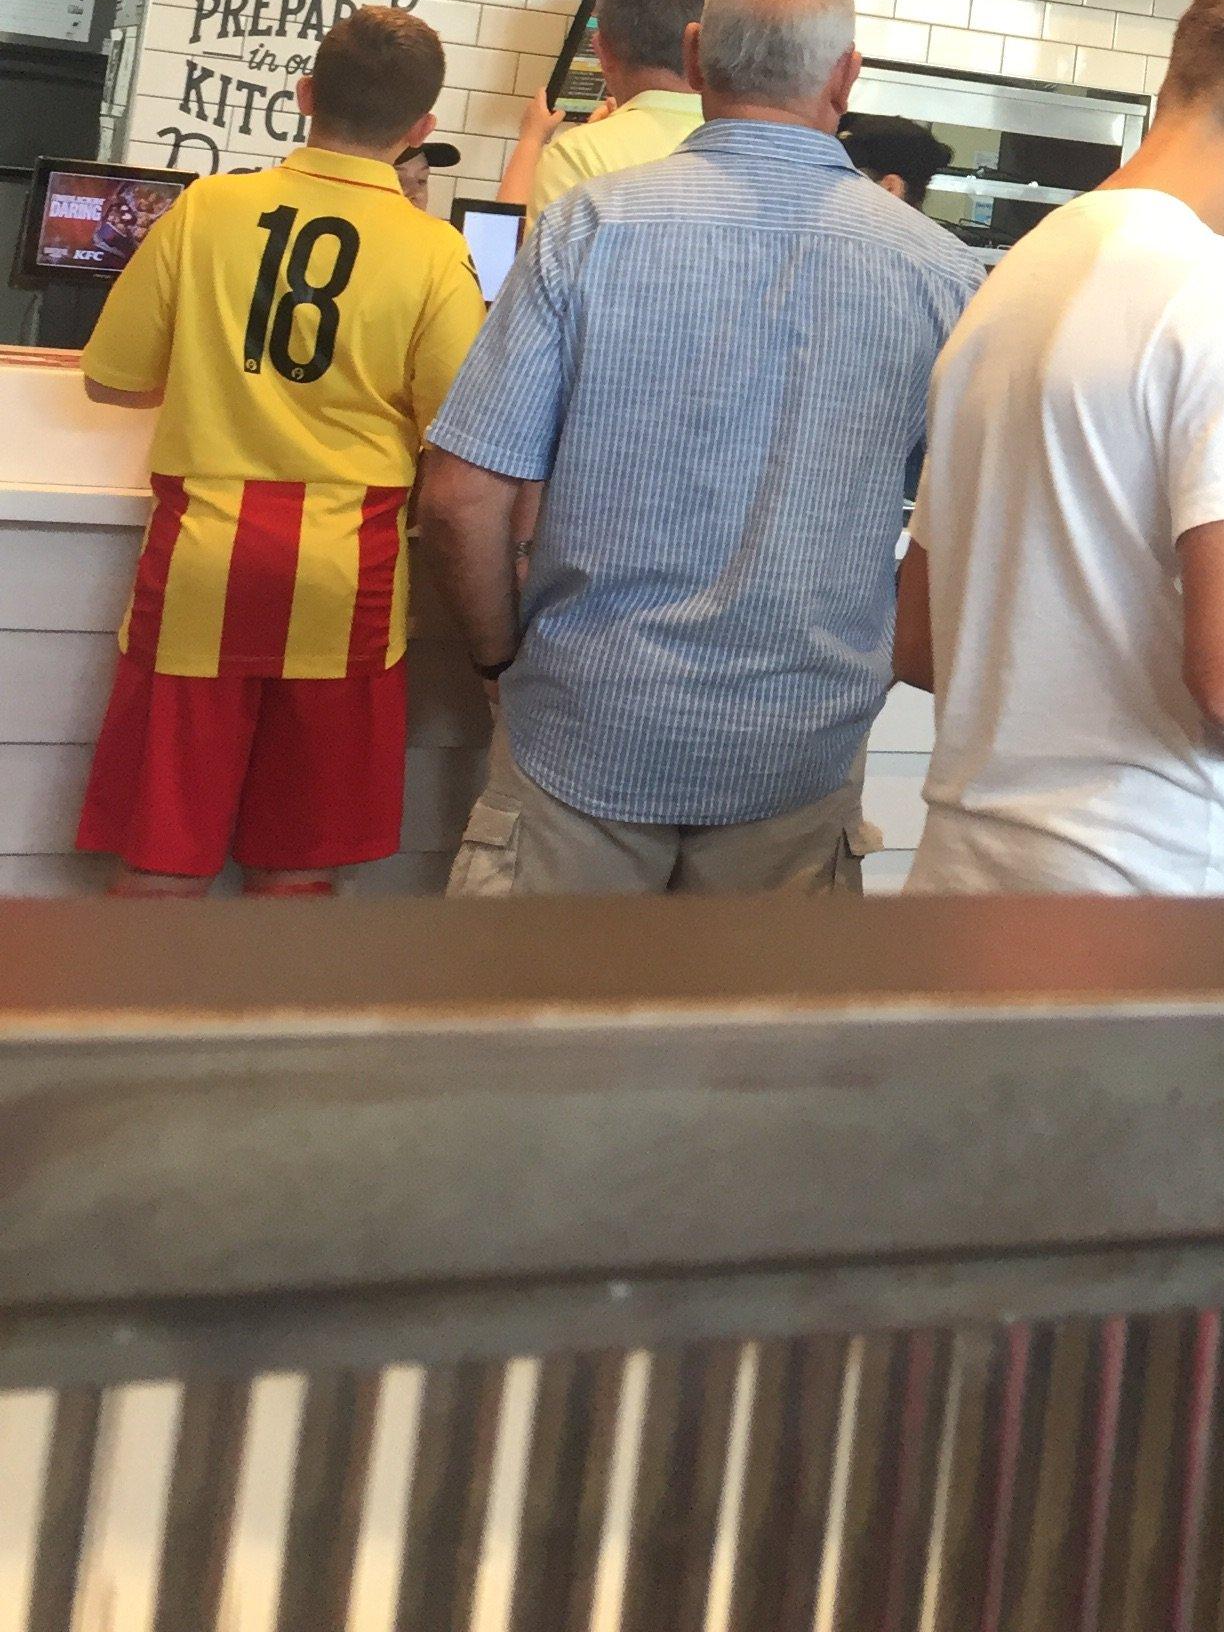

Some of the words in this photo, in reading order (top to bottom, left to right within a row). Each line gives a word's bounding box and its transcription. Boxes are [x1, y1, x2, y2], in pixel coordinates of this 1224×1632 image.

[249, 42, 279, 73] in
[73, 249, 104, 262] KFC
[244, 204, 361, 384] 18
